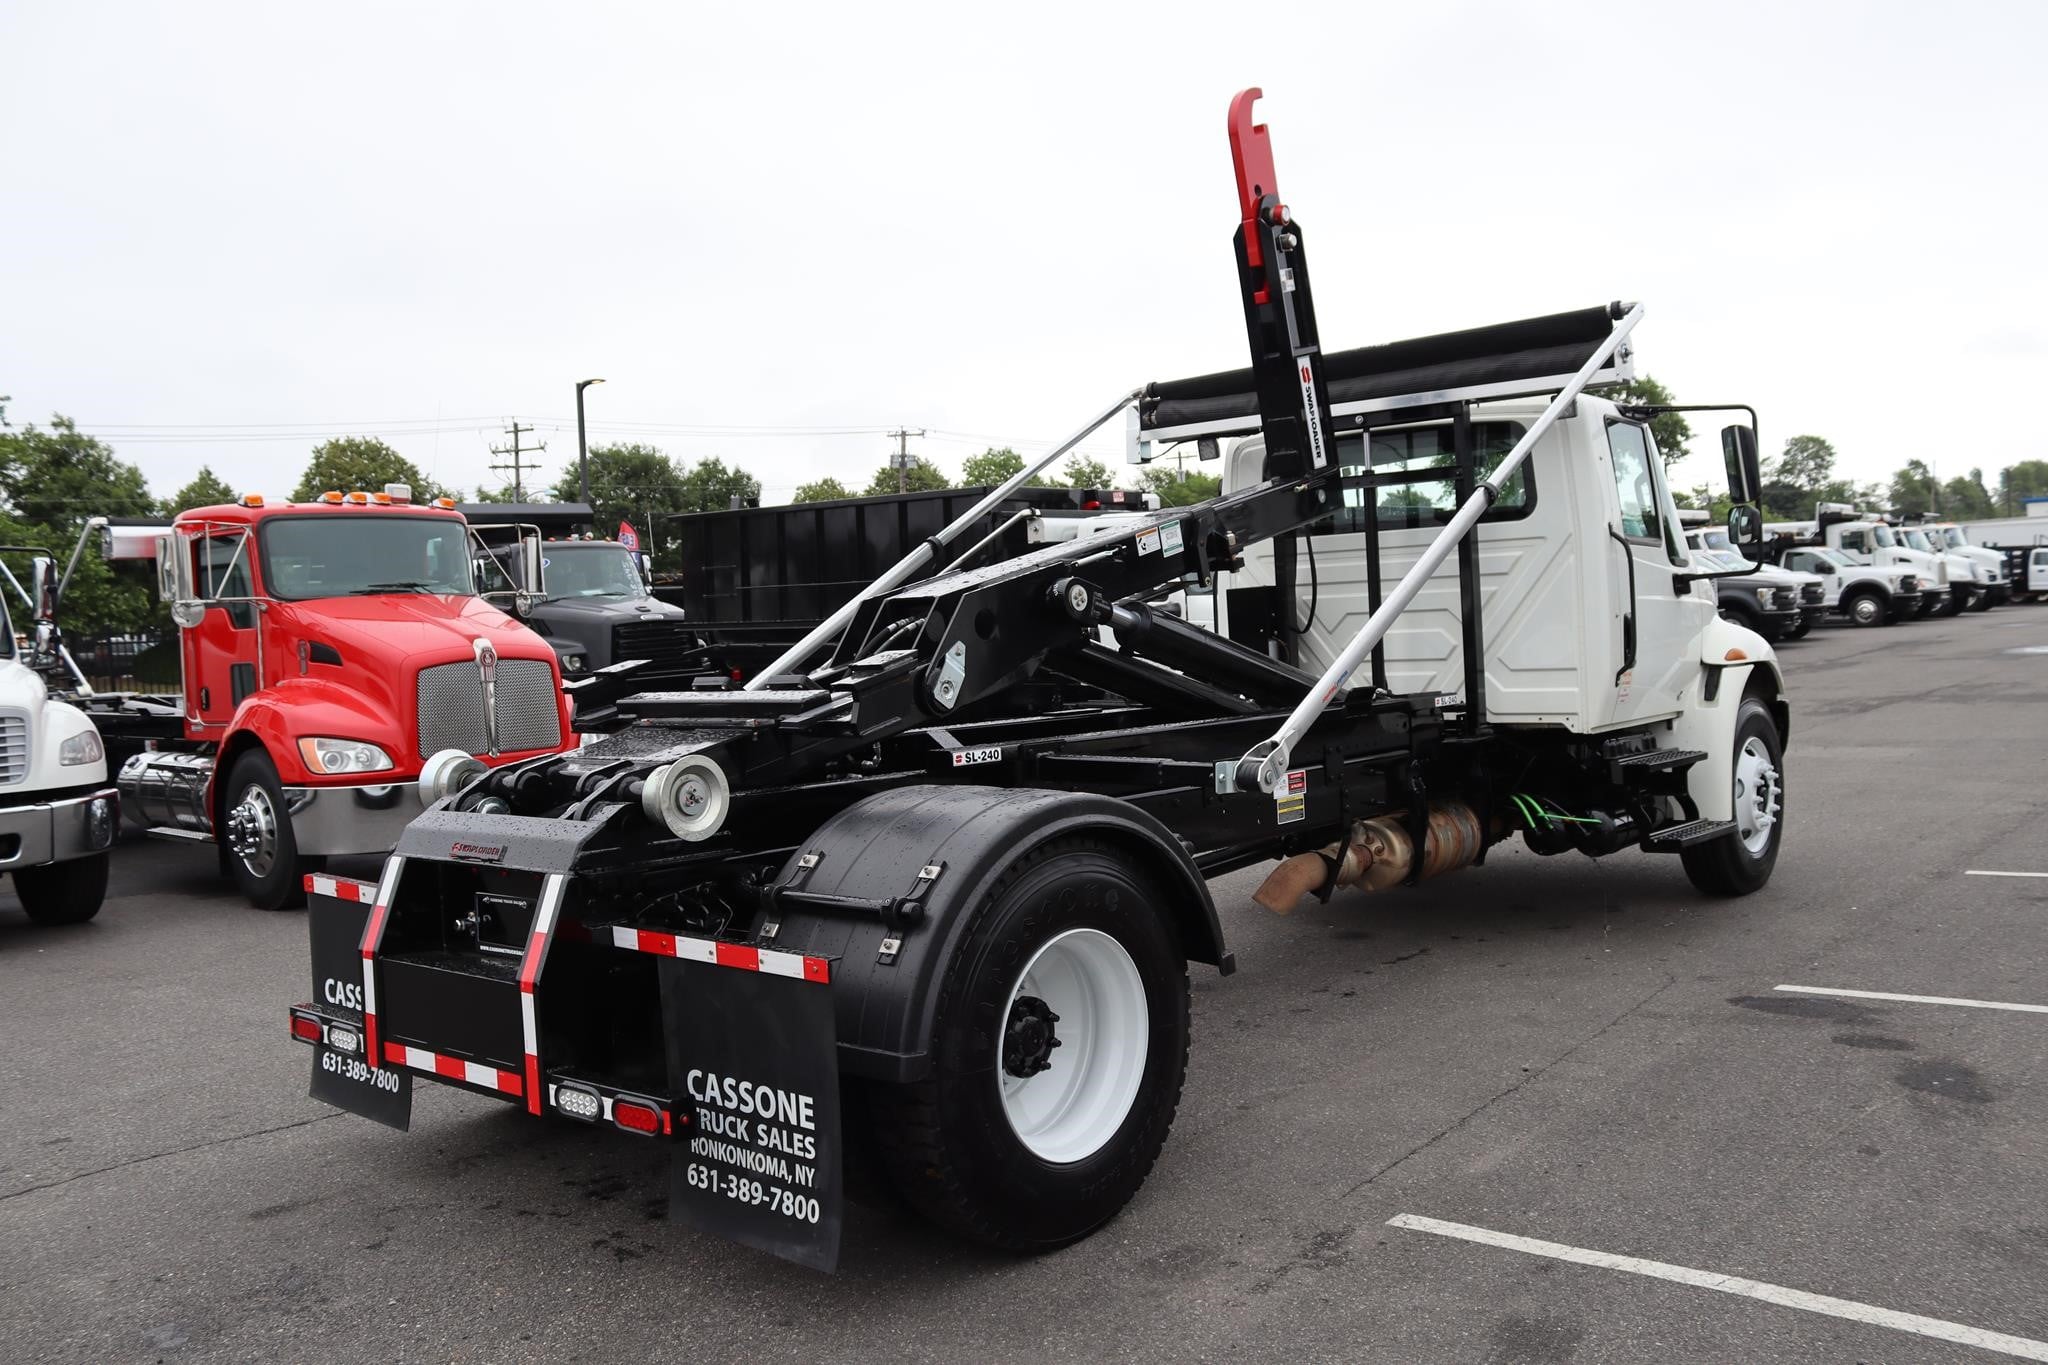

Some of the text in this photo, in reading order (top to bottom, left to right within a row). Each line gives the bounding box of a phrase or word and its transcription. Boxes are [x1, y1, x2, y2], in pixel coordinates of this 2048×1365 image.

[1305, 386, 1322, 458] SWAPLOADER
[965, 749, 1000, 763] SL-240
[324, 978, 362, 1011] CASS
[322, 1051, 399, 1093] 631-389-7800
[686, 1068, 816, 1131] CASSONE
[695, 1106, 816, 1160] RUCK SALES
[687, 1162, 820, 1224] 631-389-7800
[795, 1163, 815, 1188] NY
